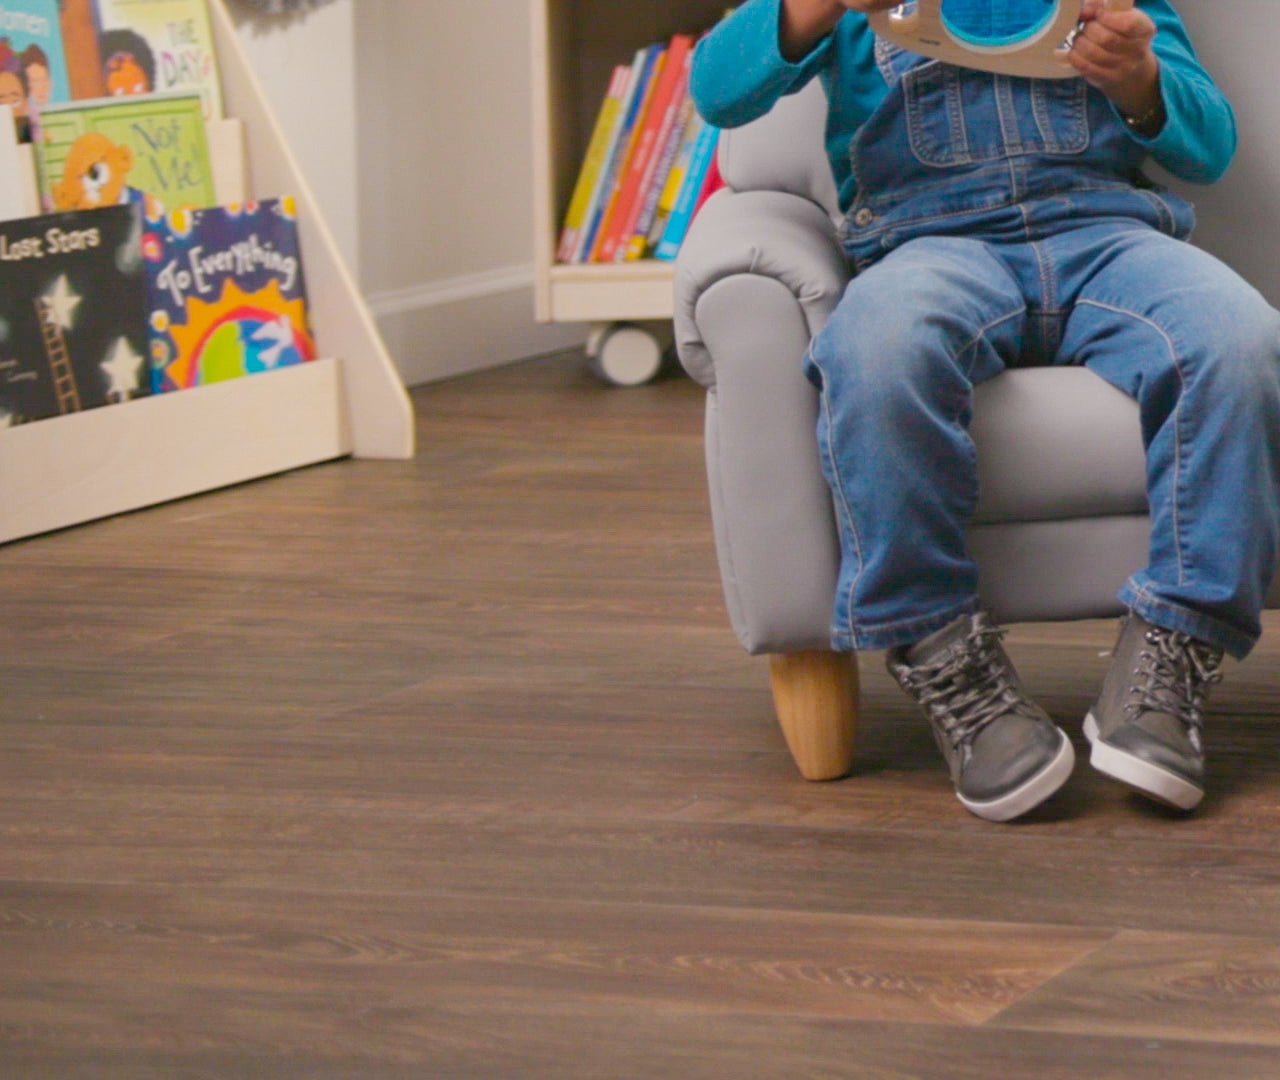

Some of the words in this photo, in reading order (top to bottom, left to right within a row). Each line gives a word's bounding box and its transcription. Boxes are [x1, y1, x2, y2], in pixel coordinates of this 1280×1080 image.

[45, 227, 100, 254] Stars
[156, 258, 191, 307] To
[188, 233, 298, 294] Everything
